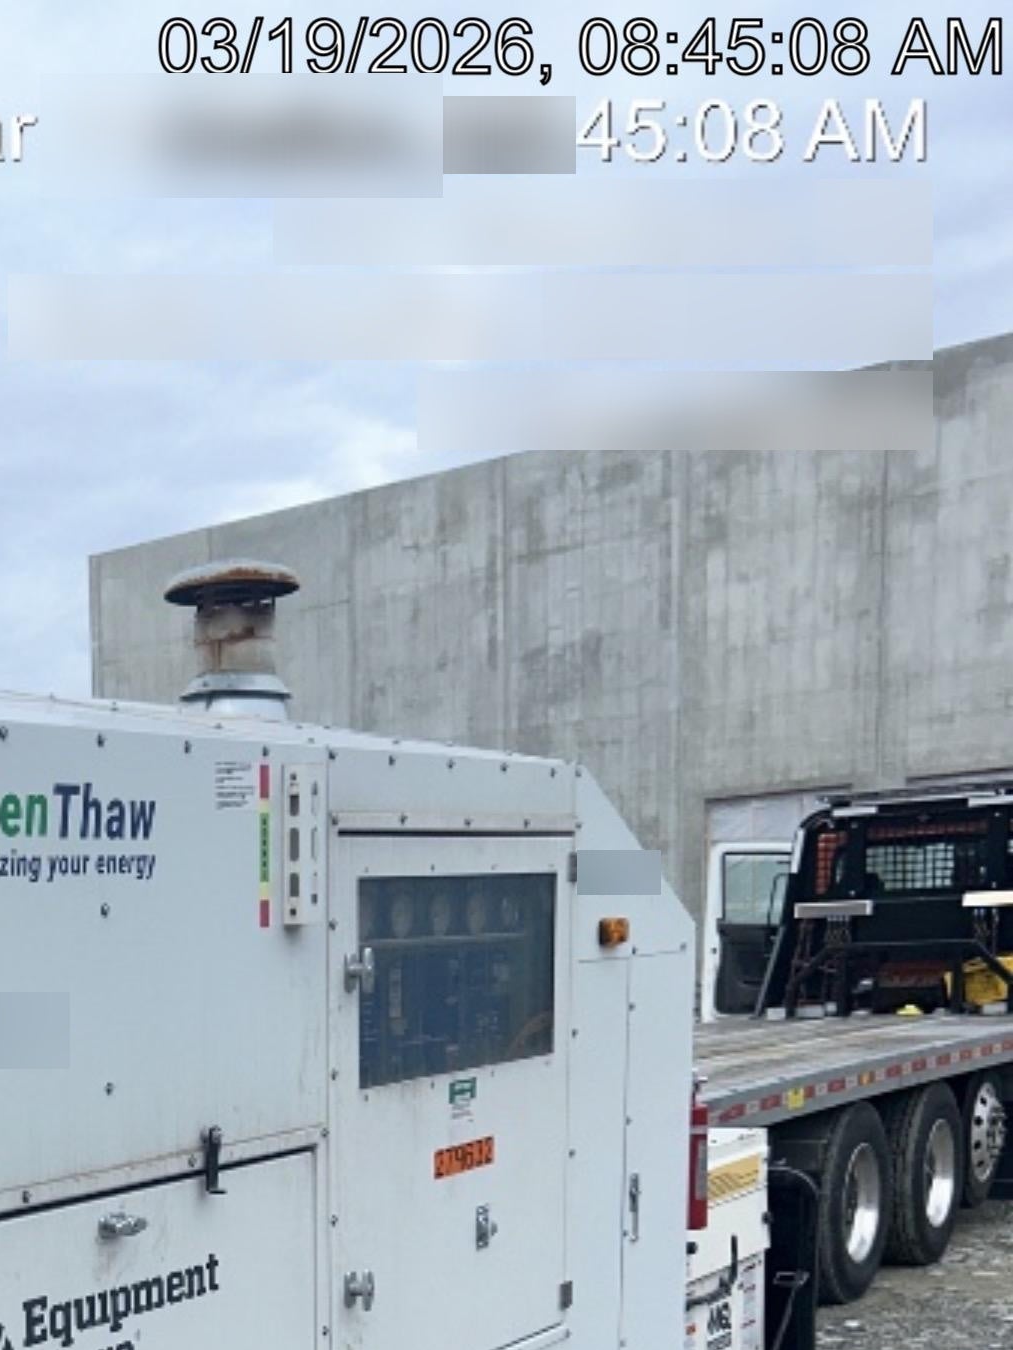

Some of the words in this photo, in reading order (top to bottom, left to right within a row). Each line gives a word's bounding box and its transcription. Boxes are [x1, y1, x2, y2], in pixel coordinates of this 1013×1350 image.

[47, 855, 89, 883] your
[95, 854, 156, 880] energy
[22, 1254, 219, 1347] Equipment
